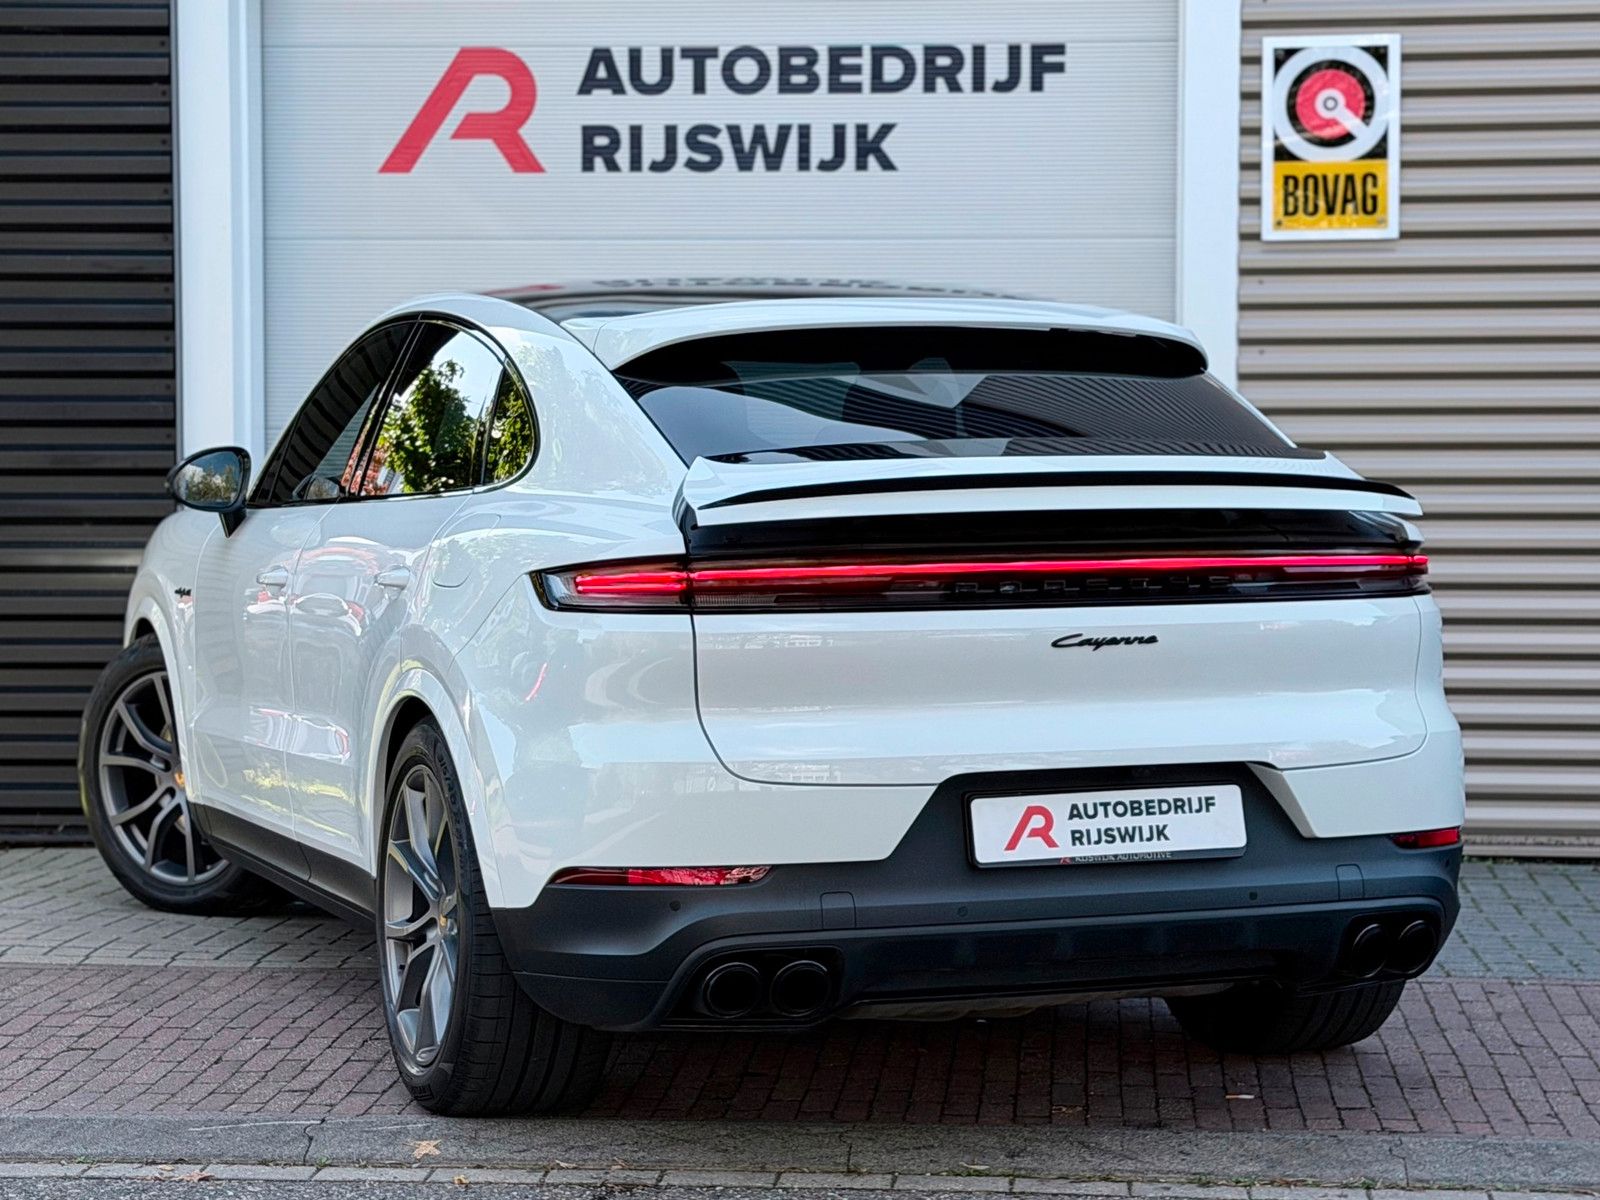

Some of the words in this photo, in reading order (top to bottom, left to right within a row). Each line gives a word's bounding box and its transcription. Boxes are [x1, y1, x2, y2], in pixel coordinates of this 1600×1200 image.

[577, 43, 1066, 96] AUTOBEDRIJF
[581, 123, 898, 173] RIJSWIJK
[1282, 172, 1379, 217] BOVAG
[1050, 632, 1160, 652] Cayenne
[1067, 796, 1217, 821] AUTOBEDRIJF
[1070, 824, 1170, 847] RIJSWIJK
